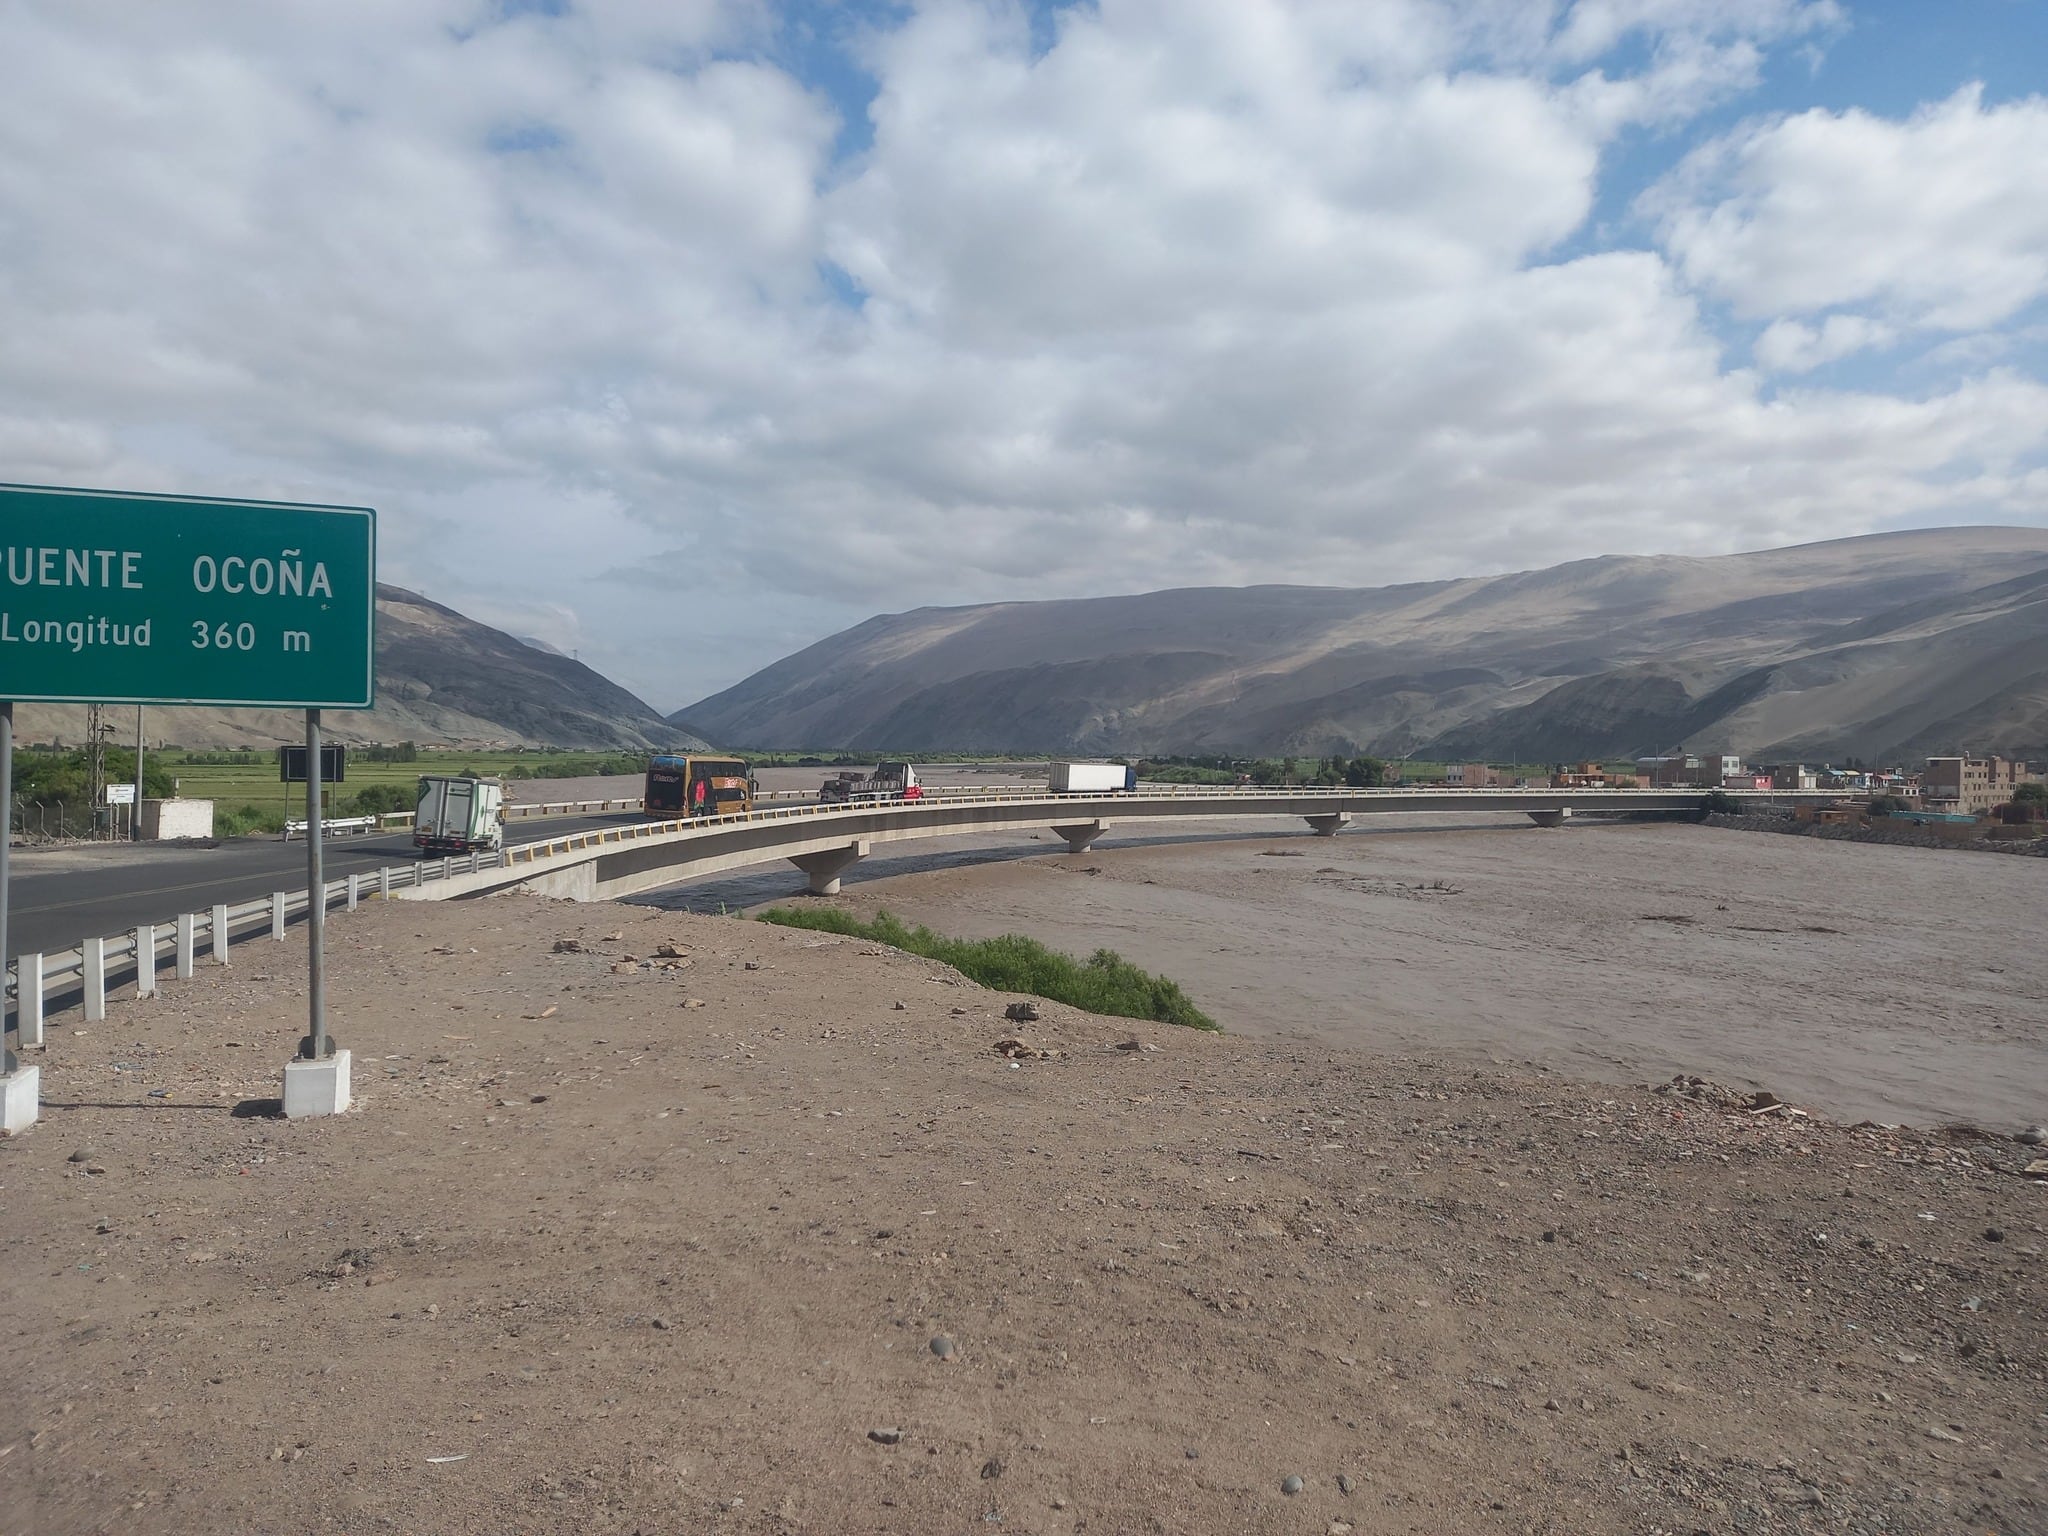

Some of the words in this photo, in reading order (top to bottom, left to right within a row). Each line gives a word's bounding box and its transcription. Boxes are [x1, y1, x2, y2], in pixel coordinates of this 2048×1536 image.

[0, 547, 143, 589] UENTE
[193, 548, 333, 598] OCOÑA
[1, 613, 151, 653] Longitud
[191, 620, 256, 651] 360
[283, 630, 311, 652] m
